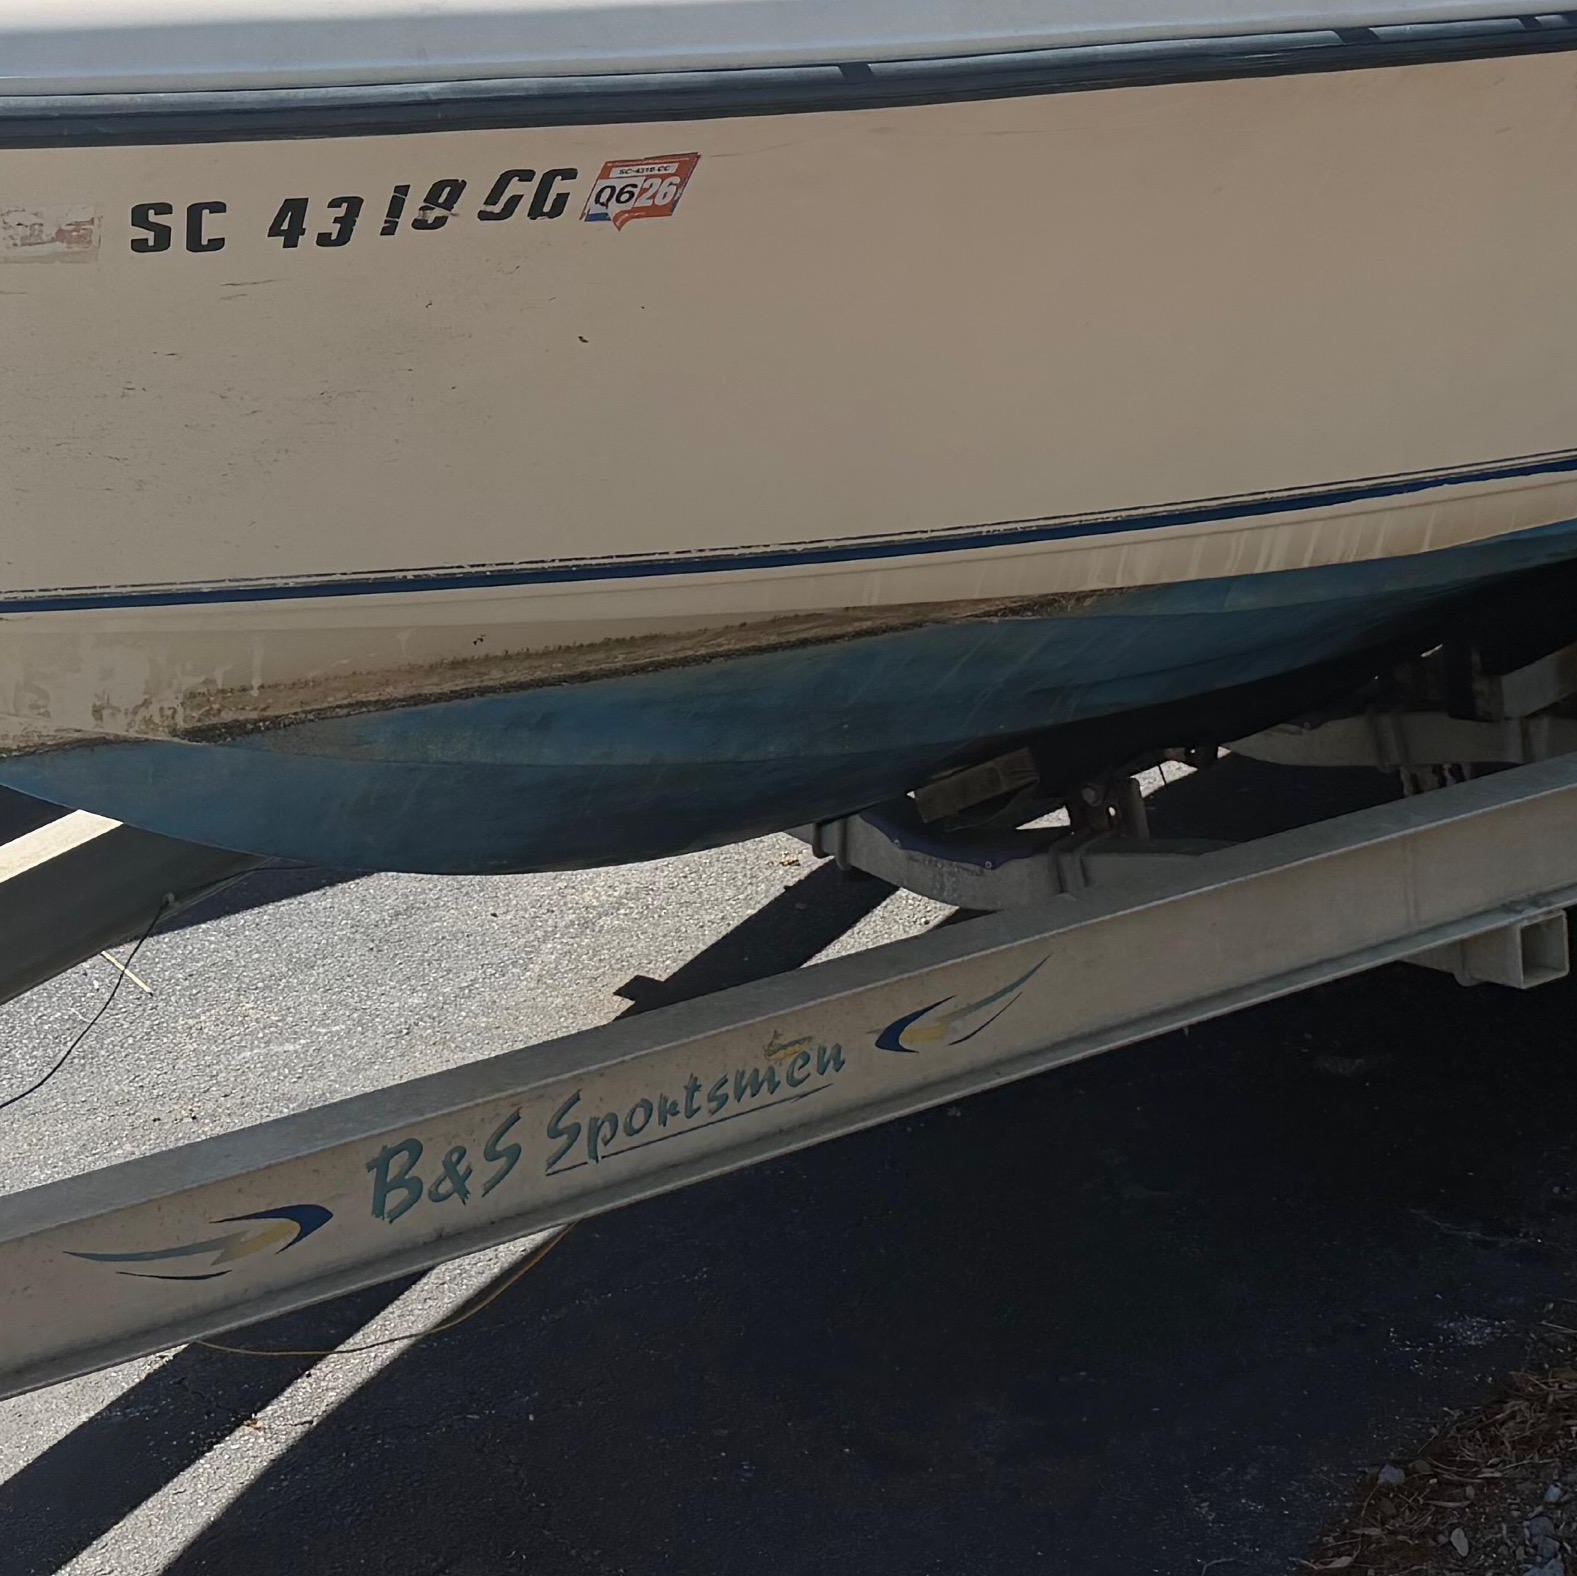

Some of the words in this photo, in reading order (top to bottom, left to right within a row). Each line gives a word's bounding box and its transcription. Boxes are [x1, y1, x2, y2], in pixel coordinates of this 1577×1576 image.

[635, 176, 681, 208] 26
[130, 201, 227, 253] SC
[366, 1106, 522, 1224] B&S
[545, 1042, 845, 1174] Sportsmen
